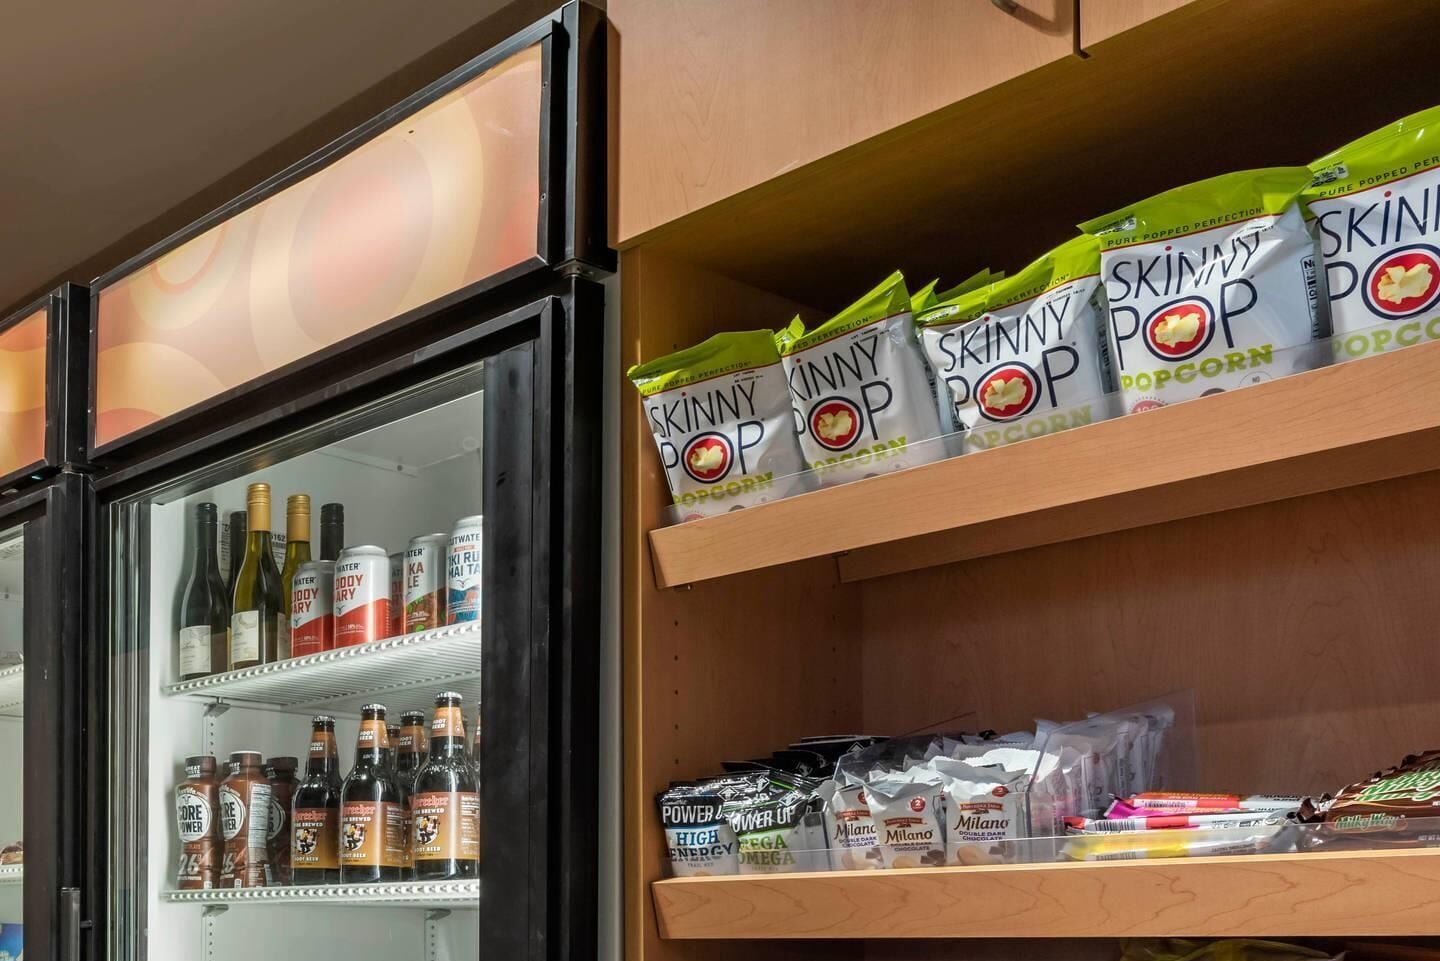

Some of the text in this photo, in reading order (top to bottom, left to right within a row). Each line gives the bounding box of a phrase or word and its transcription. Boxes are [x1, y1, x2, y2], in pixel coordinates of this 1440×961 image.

[1320, 184, 1353, 198] PURE
[1359, 166, 1409, 187] POPPED
[1414, 155, 1440, 170] PER
[1107, 207, 1264, 247] PURE POPPED PERFECTION
[1109, 231, 1261, 302] SKINNY
[812, 316, 872, 342] PERFECTION
[1110, 277, 1258, 371] POP
[938, 297, 1071, 372] SKINNY
[1332, 316, 1440, 358] POPCO
[698, 362, 750, 378] PERFECTION
[789, 335, 879, 401] KINNY
[1121, 343, 1274, 391] POPCORN
[945, 345, 1079, 429] POP
[650, 380, 755, 438] SKINNY
[964, 404, 1093, 449] OPCORN
[660, 420, 765, 491] POP
[449, 533, 480, 546] UTWATE
[463, 551, 480, 564] RU
[336, 562, 361, 573] WATER
[466, 562, 480, 575] TA
[293, 576, 316, 586] WATER
[335, 588, 357, 603] ARY
[292, 600, 312, 615] ARY
[224, 801, 236, 818] RE
[342, 804, 376, 816] precher
[414, 795, 449, 806] precher
[662, 804, 714, 824] POWER
[776, 804, 796, 825] UP
[954, 814, 1010, 831] Milano
[181, 821, 203, 833] OWER
[886, 828, 934, 844] Milano
[676, 829, 721, 847] HIGH
